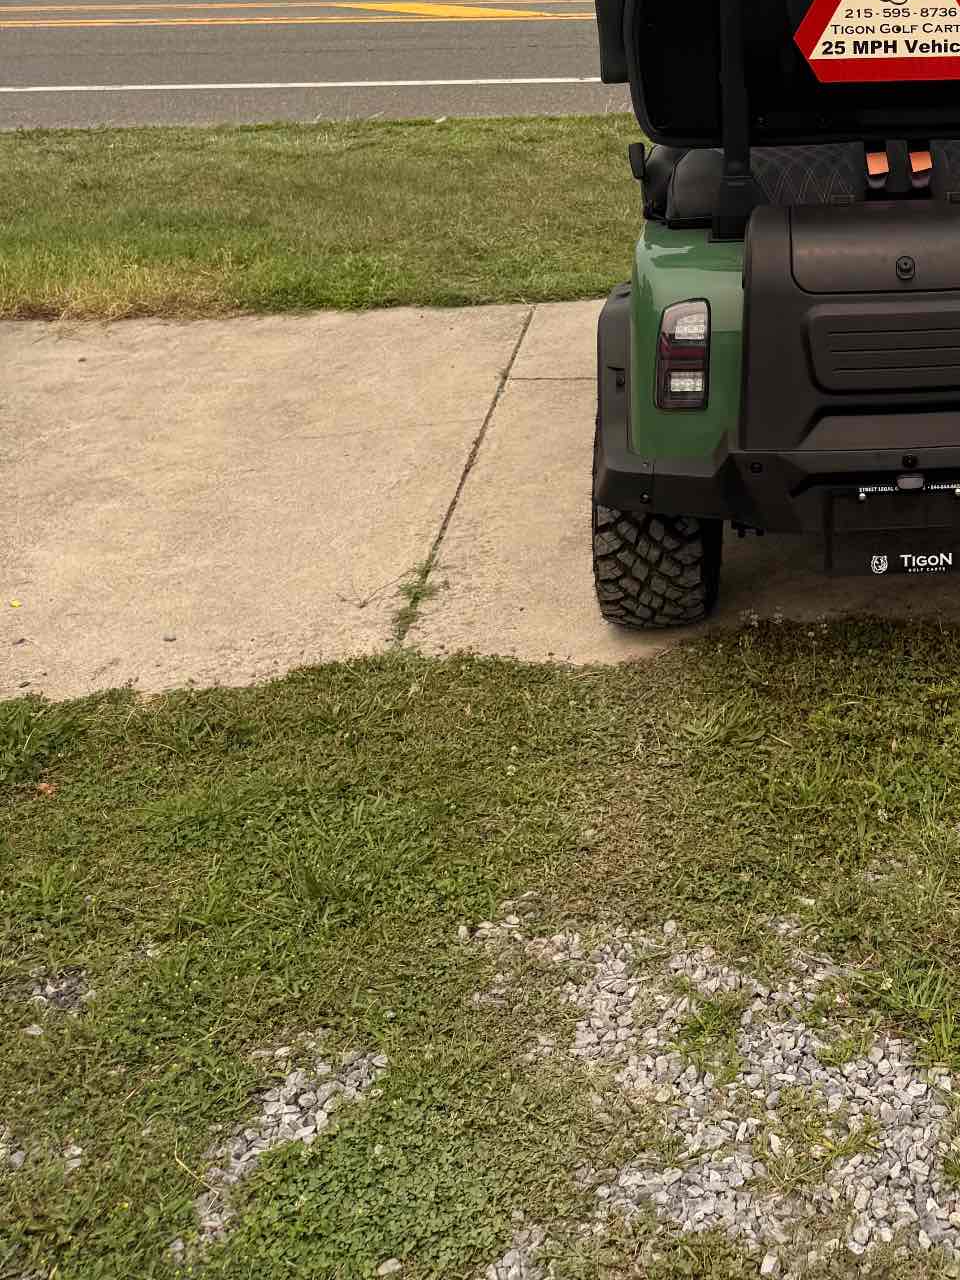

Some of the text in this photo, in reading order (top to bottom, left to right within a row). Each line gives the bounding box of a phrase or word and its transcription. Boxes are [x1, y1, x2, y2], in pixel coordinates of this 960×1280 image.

[831, 23, 875, 35] TIGON
[879, 22, 918, 34] GOLF
[822, 40, 846, 55] 25
[853, 39, 898, 55] MPH
[899, 552, 953, 568] TIGON
